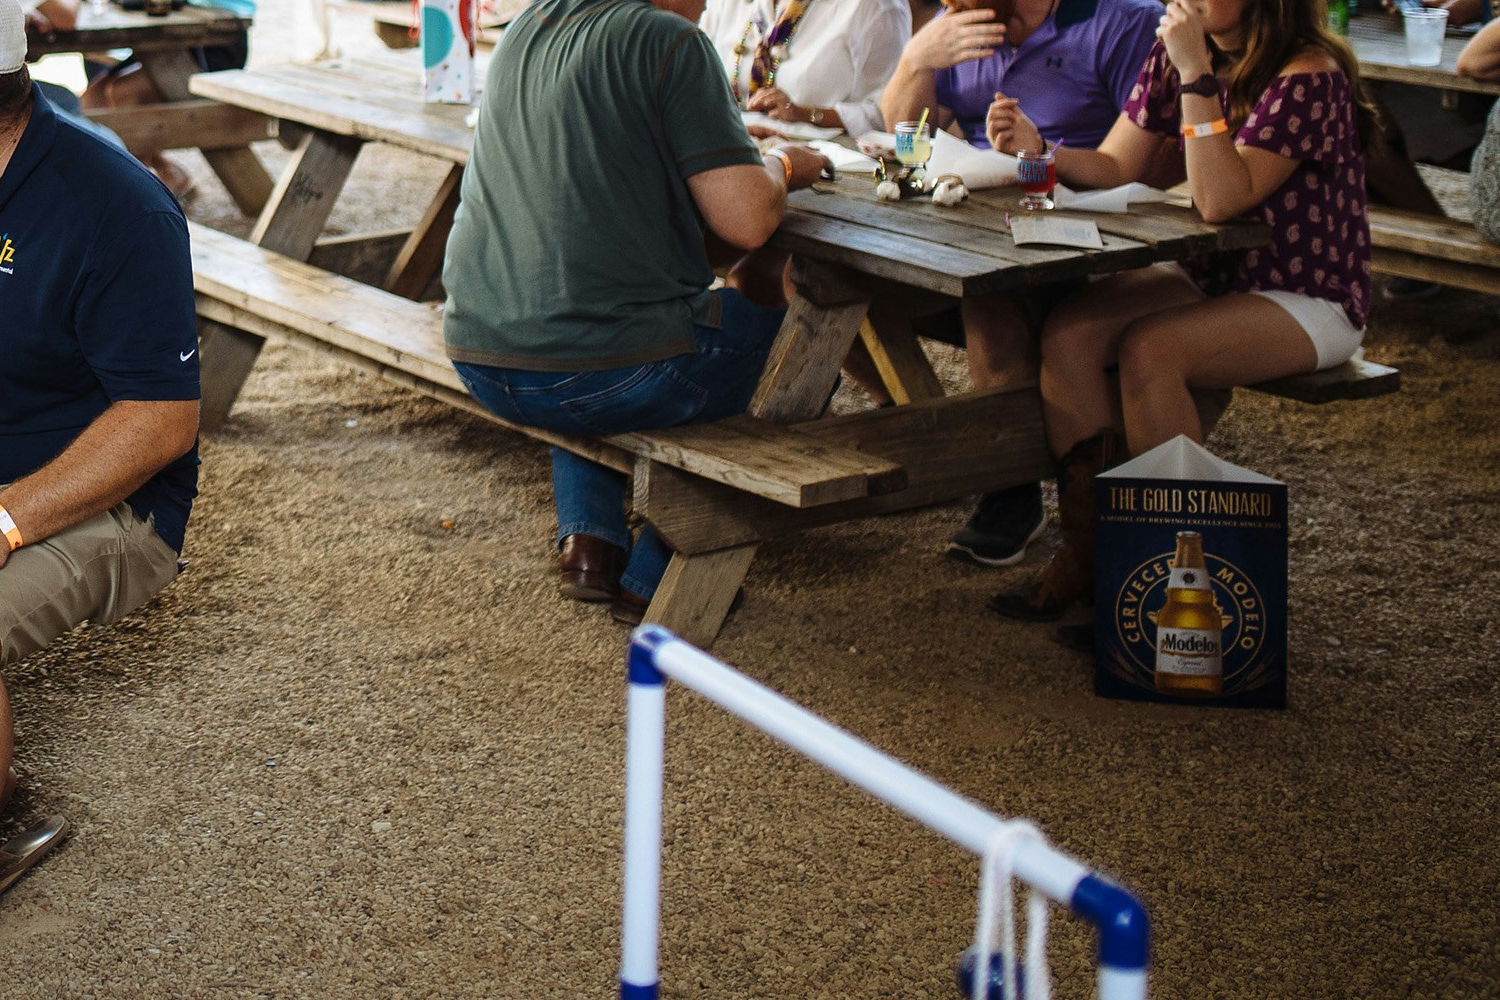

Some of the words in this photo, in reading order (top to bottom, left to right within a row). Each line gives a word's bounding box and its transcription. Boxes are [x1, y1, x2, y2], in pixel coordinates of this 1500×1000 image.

[1109, 486, 1138, 512] THE
[1143, 487, 1183, 514] GOLD
[1187, 488, 1273, 518] STANDARD
[1216, 566, 1261, 650] MODELO
[1165, 633, 1215, 653] Modelo
